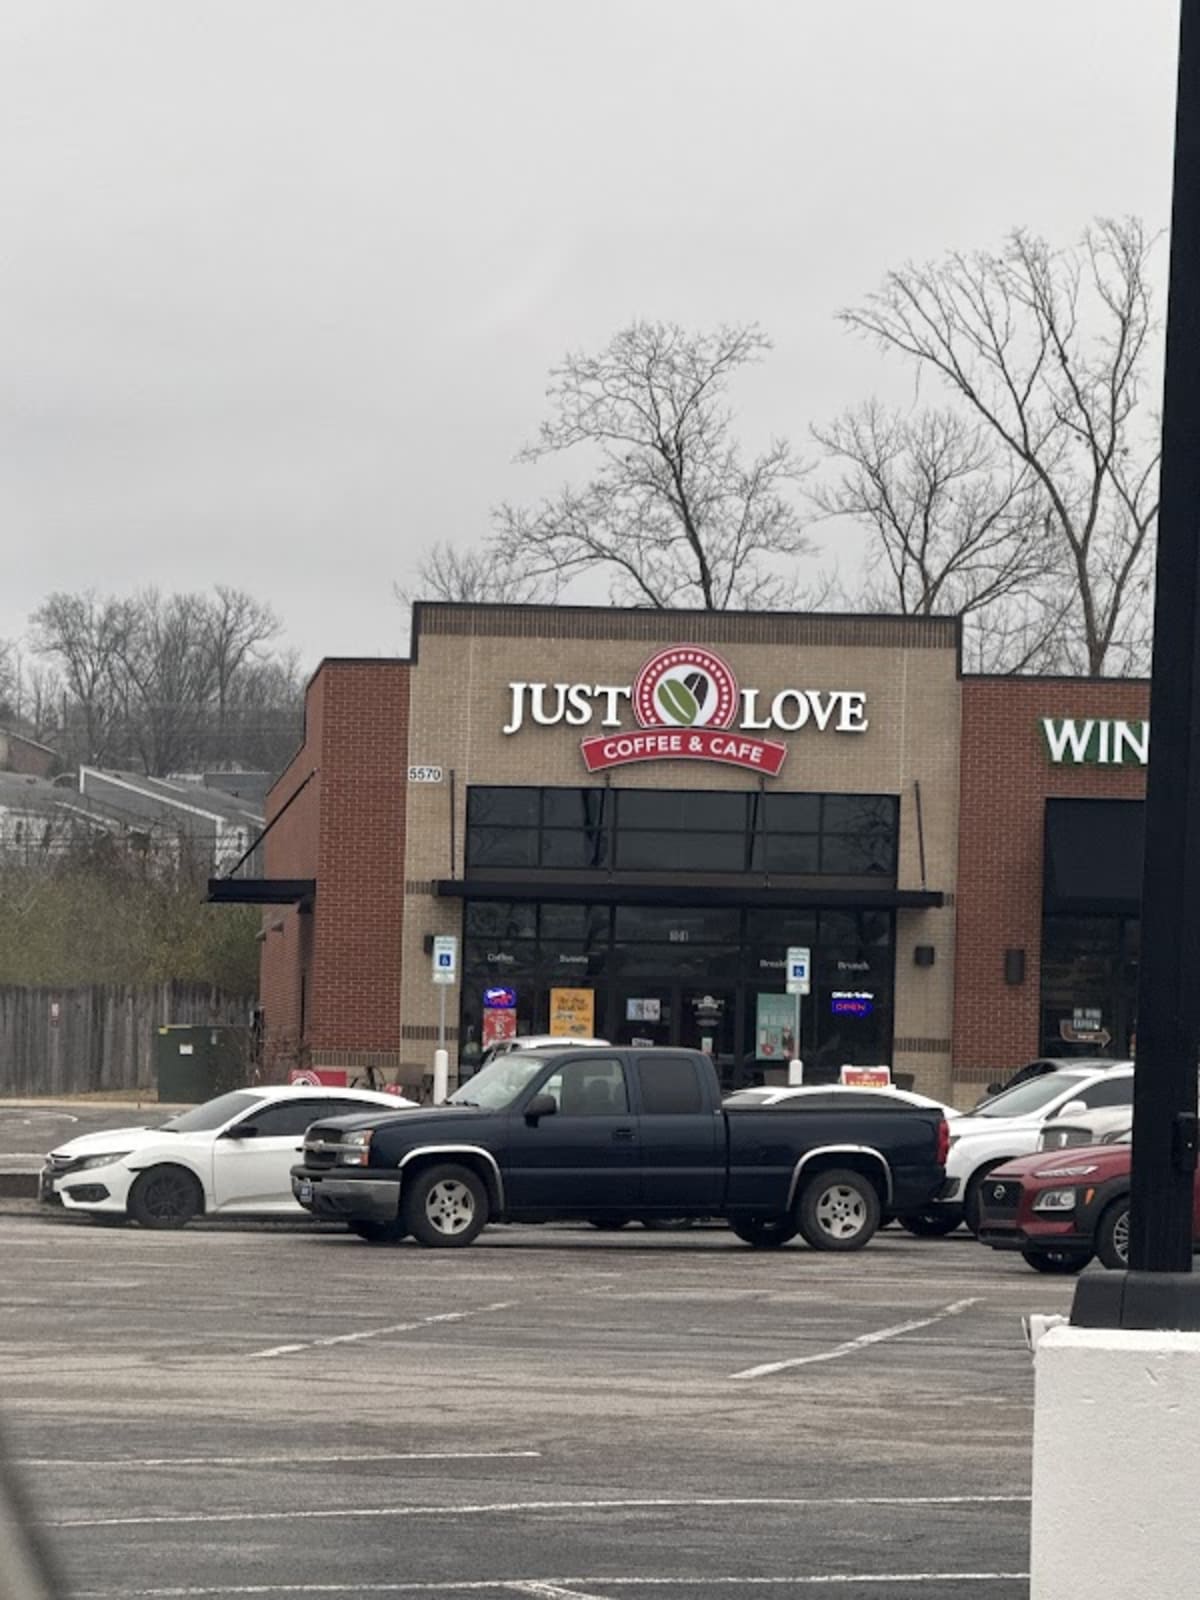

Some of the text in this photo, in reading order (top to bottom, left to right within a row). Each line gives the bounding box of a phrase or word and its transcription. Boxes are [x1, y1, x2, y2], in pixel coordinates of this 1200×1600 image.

[503, 682, 868, 734] JUST LOVE
[603, 735, 764, 763] COFFEE & CAFE
[1043, 718, 1149, 764] WIN
[409, 767, 441, 781] 5570
